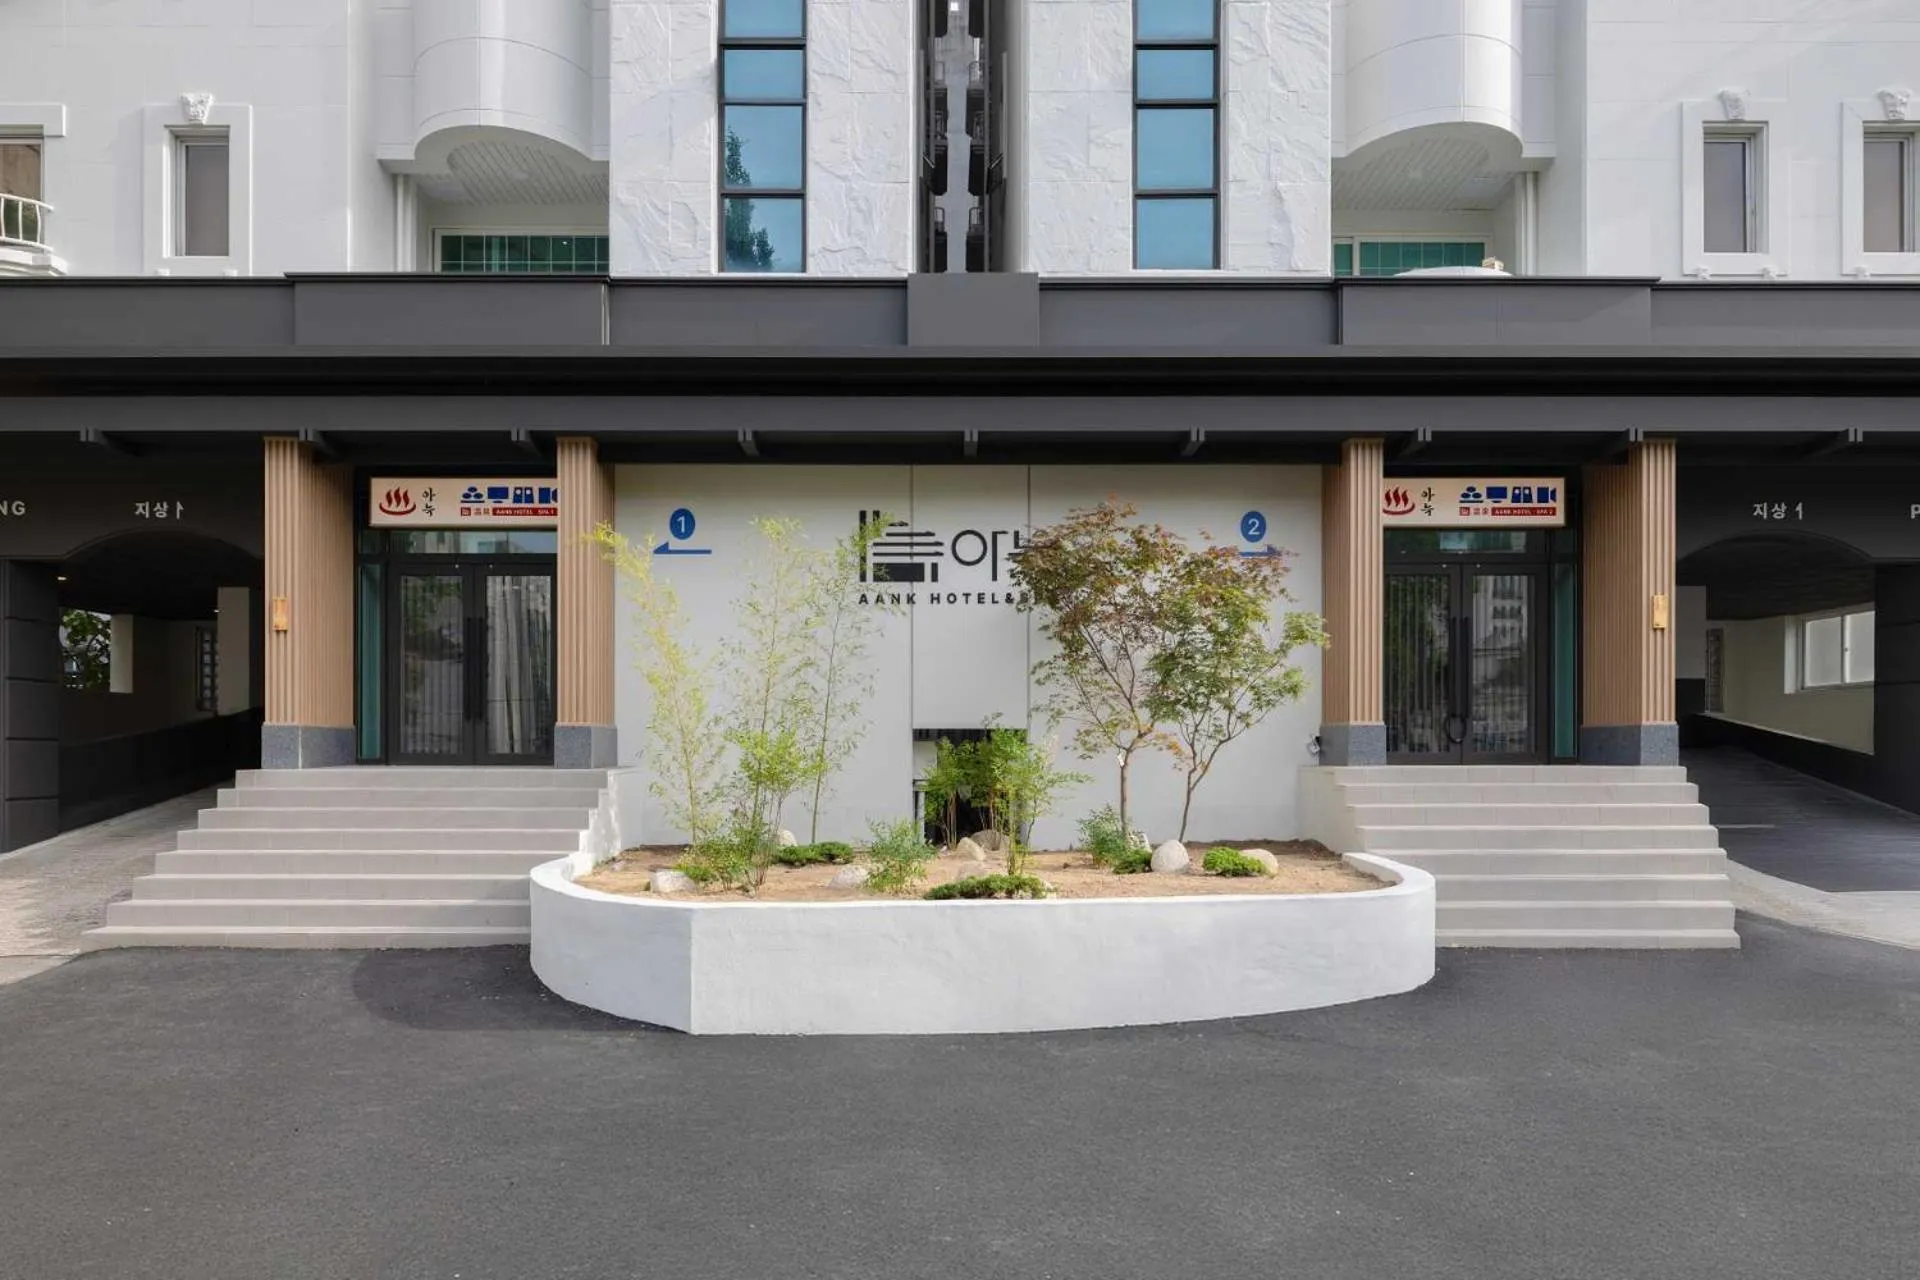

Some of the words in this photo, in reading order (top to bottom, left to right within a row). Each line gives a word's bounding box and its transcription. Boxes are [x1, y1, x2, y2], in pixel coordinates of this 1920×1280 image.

[135, 501, 169, 519] 지상
[1752, 501, 1787, 520] 지상
[676, 515, 686, 534] 1
[1247, 518, 1260, 536] 2
[858, 592, 916, 605] AANK
